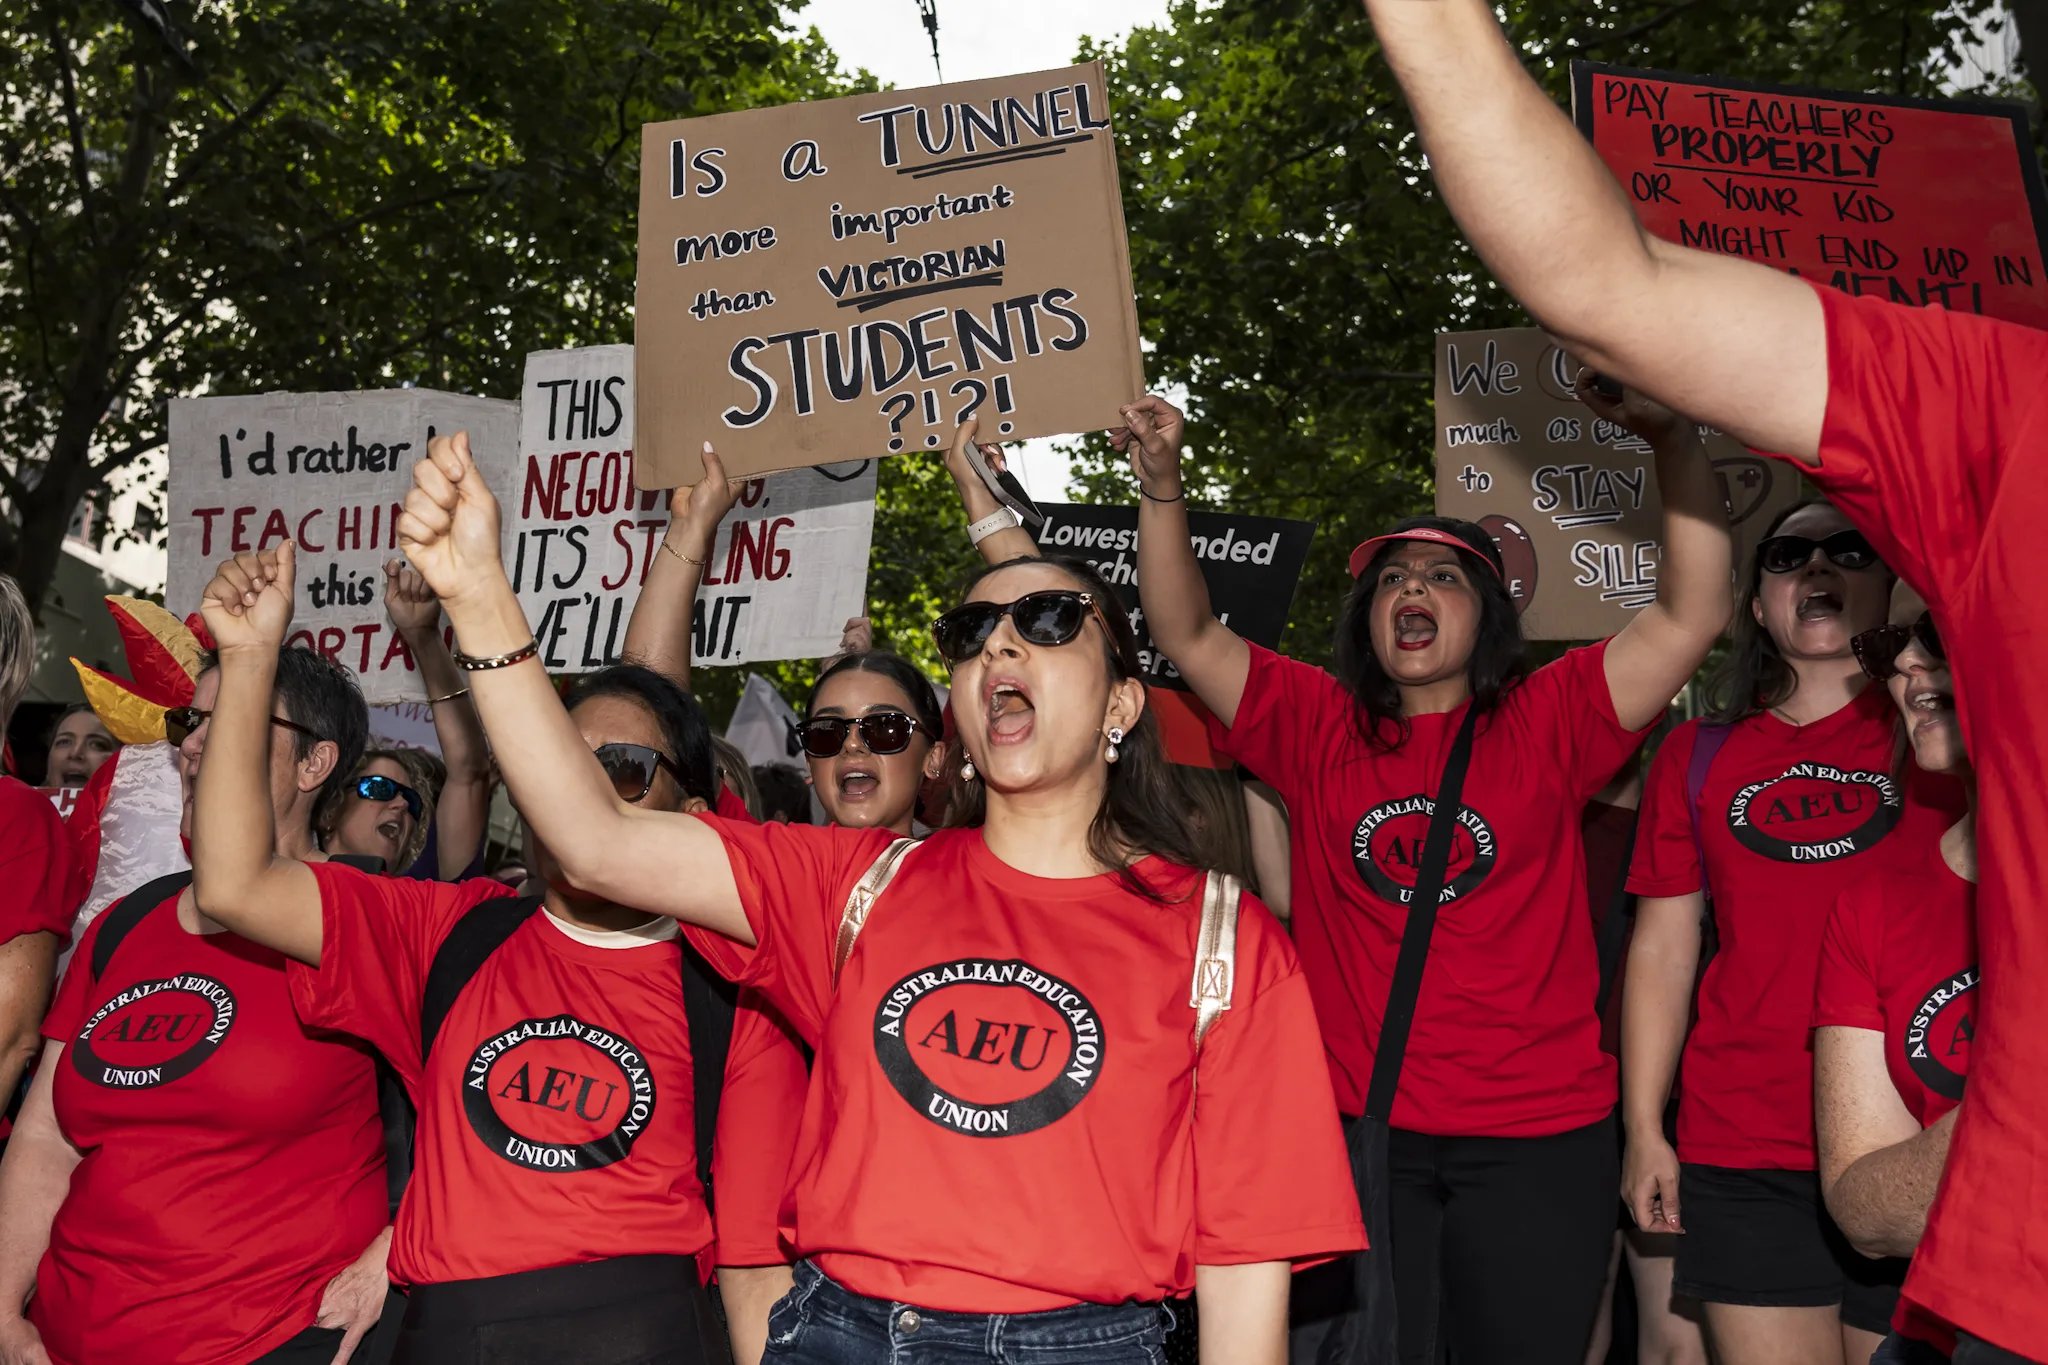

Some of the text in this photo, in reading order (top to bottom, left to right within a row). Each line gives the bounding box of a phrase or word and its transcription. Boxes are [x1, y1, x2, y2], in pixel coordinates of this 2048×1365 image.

[669, 83, 1110, 199] Is a TUNNEL
[1604, 80, 1894, 145] PAY TEACHERS
[1651, 123, 1881, 179] PROPERLY
[674, 184, 1015, 266] more important
[1631, 170, 1895, 223] OR YOUR KID
[688, 239, 1007, 321] than VICTORIAN
[1679, 219, 2034, 287] MIGHT END UP IN
[721, 288, 1089, 429] STUDENTS
[1447, 339, 1522, 396] We
[537, 376, 626, 441] THIS
[1445, 418, 1520, 447] much
[1546, 418, 1582, 445] as
[219, 428, 277, 479] I'd
[287, 426, 411, 475] rather
[1457, 464, 1646, 512] to STAY
[512, 525, 590, 594] IT'S
[1190, 528, 1280, 566] nded
[1570, 540, 1664, 591] SILE
[307, 563, 375, 609] this
[1764, 788, 1864, 825] AEU
[1790, 837, 1856, 860] UNION
[79, 976, 234, 1044] AUSTRALIAN EDUCATION
[98, 1013, 205, 1043] AEU
[879, 962, 1099, 1087] AUSTRALIAN EDUCATION
[1908, 971, 1981, 1059] AUSTRAL
[917, 1009, 1059, 1072] AEU
[102, 1066, 162, 1086] UNION
[468, 1018, 652, 1138] AUSTRALIAN EDUCATION
[497, 1061, 619, 1122] AEU
[928, 1093, 1009, 1132] UNION
[505, 1136, 577, 1168] UNION
